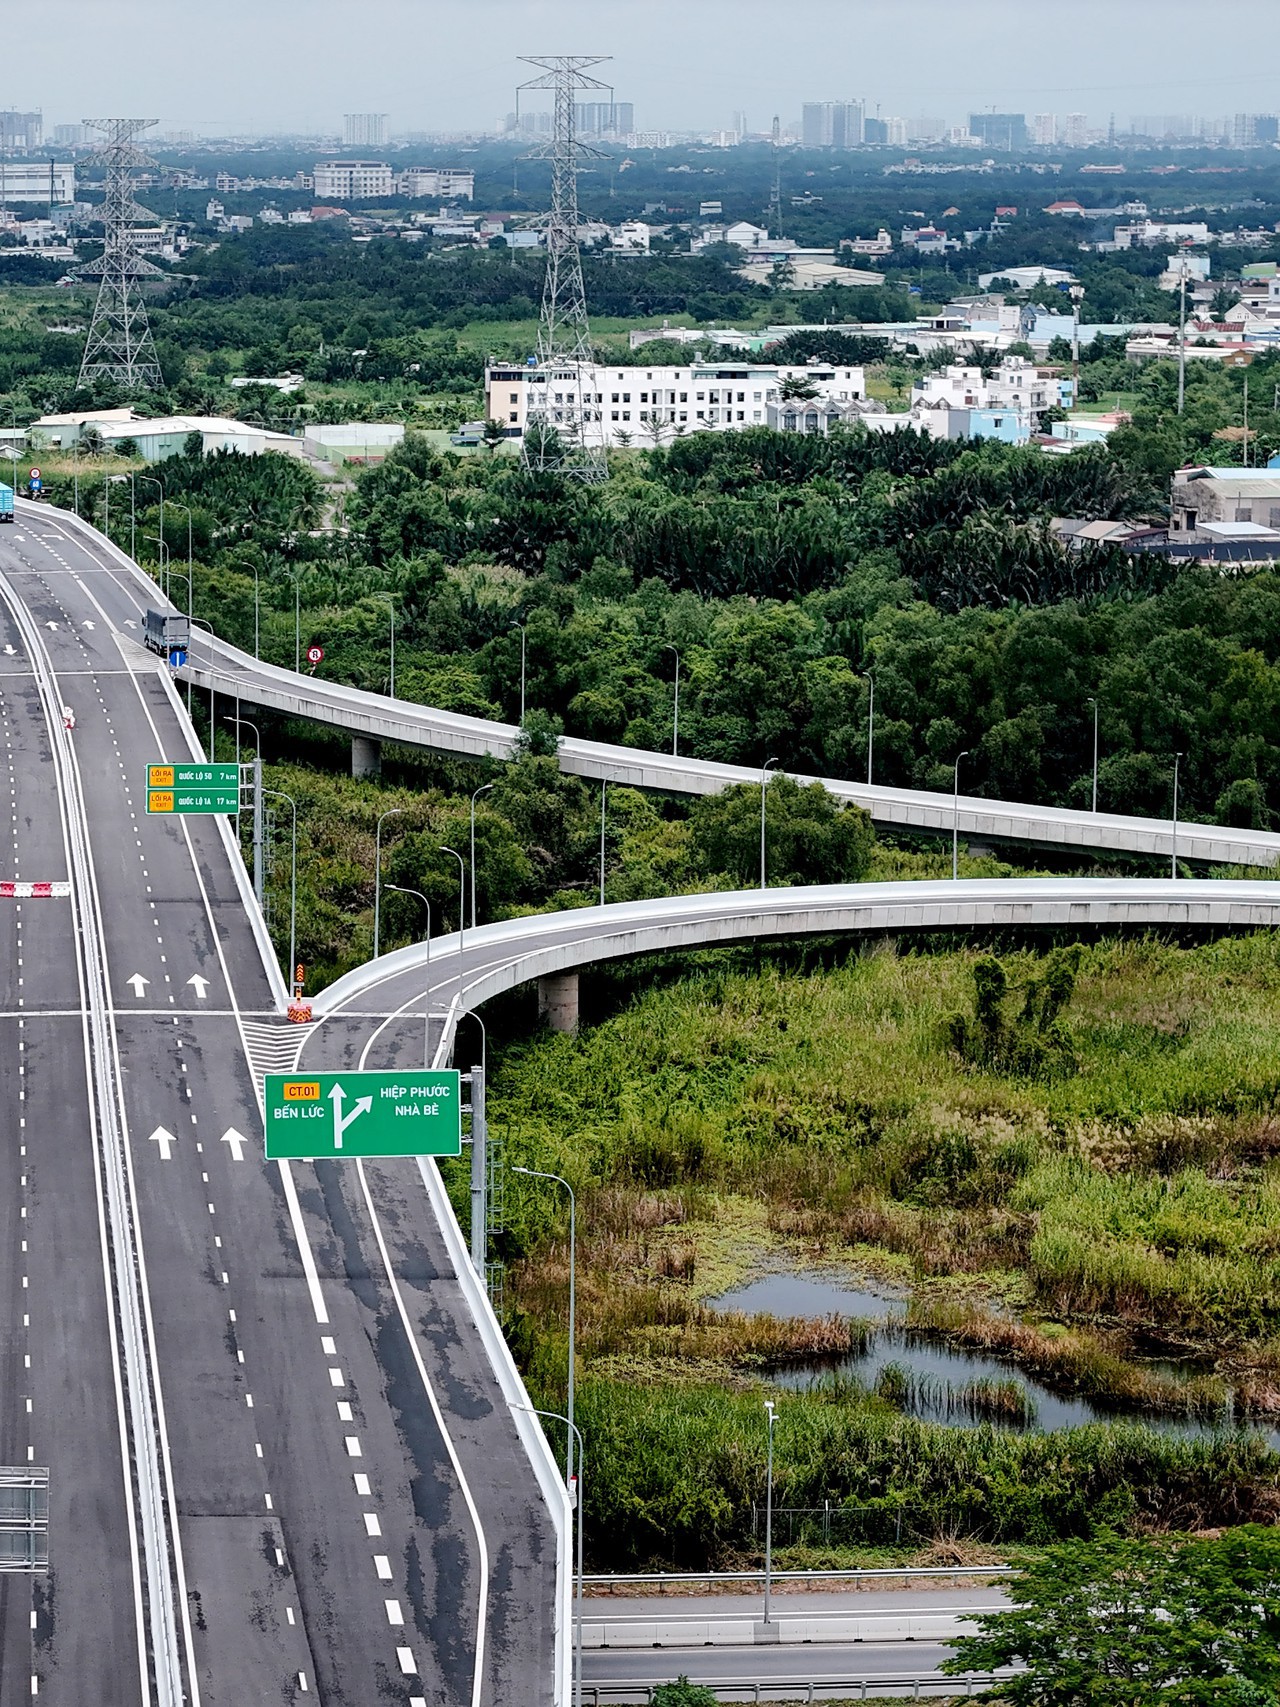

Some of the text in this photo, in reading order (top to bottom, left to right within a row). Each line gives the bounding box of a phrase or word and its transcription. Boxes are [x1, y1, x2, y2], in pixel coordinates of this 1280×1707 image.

[179, 771, 194, 780] QUỐC
[195, 772, 203, 781] LỘ
[204, 772, 212, 780] 50
[220, 772, 225, 780] 7
[179, 796, 194, 805] QUỐC
[195, 797, 203, 806] LỘ
[204, 797, 211, 805] 1A
[217, 797, 225, 805] 17
[289, 1086, 315, 1096] CT.01
[380, 1083, 450, 1100] HIỆP PHƯỚC
[274, 1104, 325, 1119] BẾN LỨC
[395, 1102, 439, 1116] NHÀ BÈ
